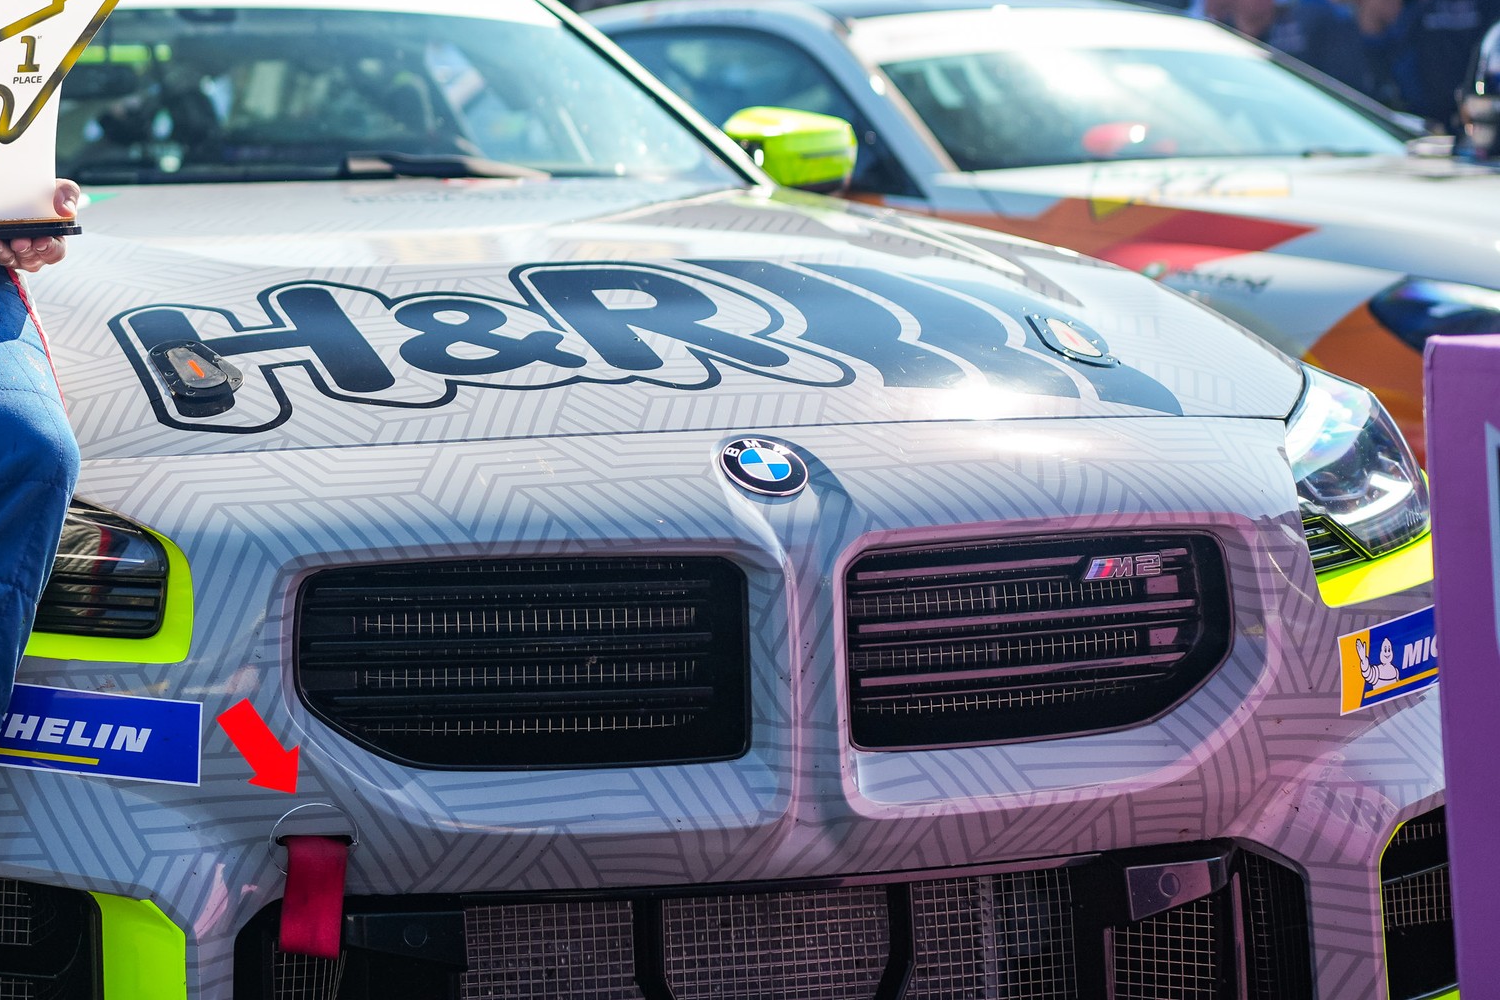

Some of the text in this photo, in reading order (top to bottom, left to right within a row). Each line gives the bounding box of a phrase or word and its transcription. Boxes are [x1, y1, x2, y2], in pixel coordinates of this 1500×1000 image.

[17, 35, 40, 73] 1
[13, 76, 43, 84] PLACE
[108, 262, 856, 432] H&R
[1109, 555, 1161, 578] M2
[3, 713, 152, 753] HELIN
